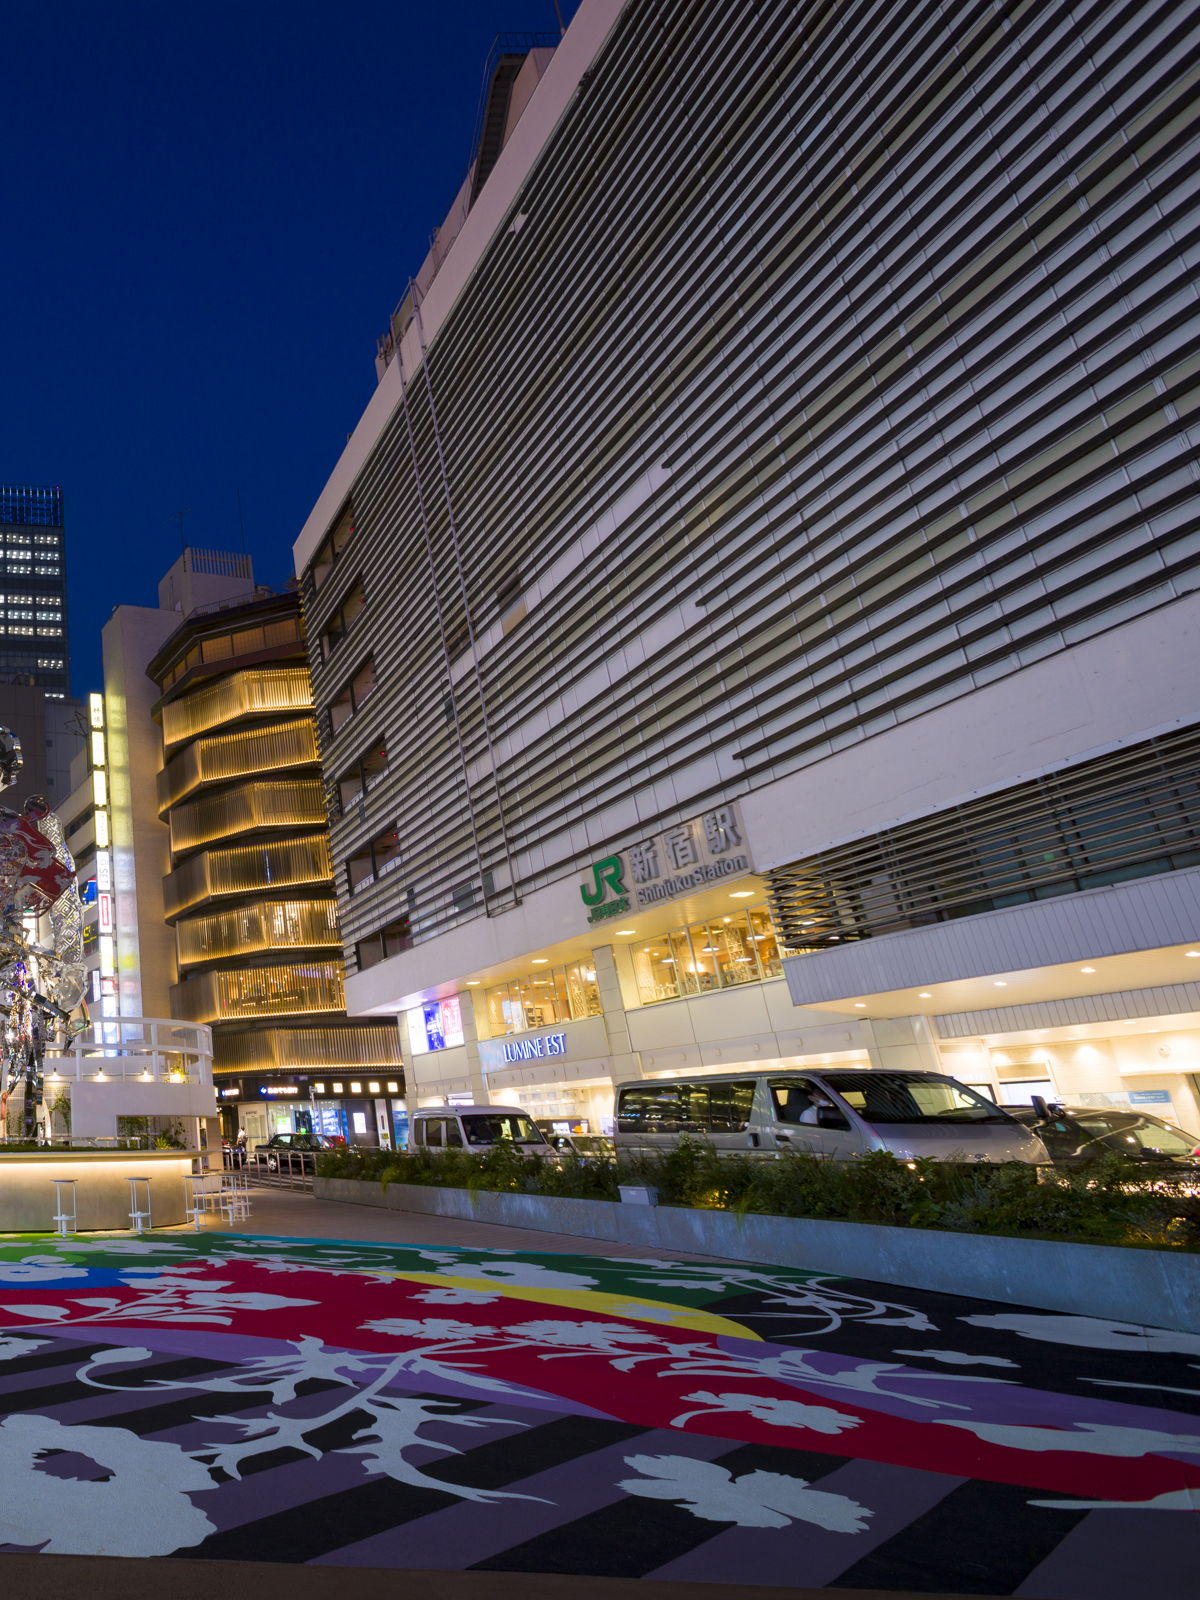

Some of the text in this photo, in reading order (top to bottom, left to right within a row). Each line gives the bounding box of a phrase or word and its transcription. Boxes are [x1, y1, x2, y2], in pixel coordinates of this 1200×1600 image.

[629, 804, 743, 884] 新宿駅
[99, 868, 108, 885] SET
[580, 854, 626, 906] JR
[636, 855, 749, 905] Shinjuku Station
[586, 897, 631, 924] JR東日本
[502, 1033, 566, 1063] LUMINE EST
